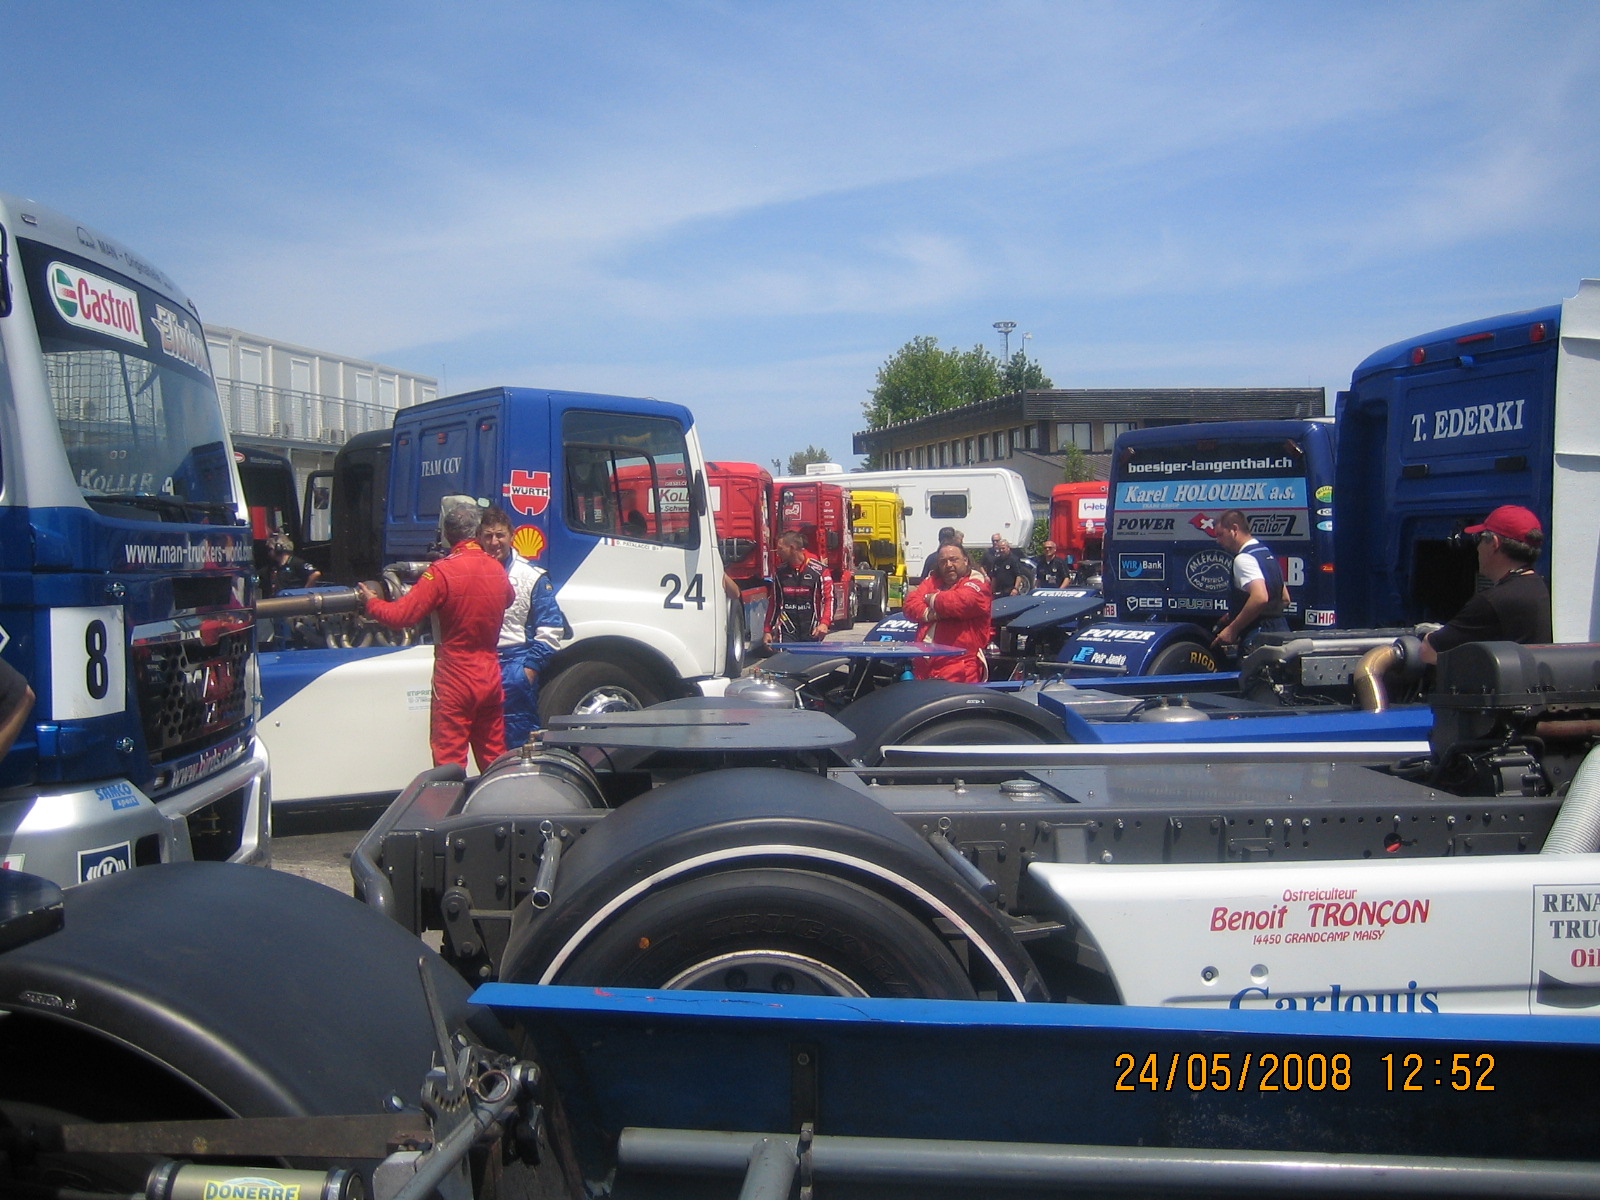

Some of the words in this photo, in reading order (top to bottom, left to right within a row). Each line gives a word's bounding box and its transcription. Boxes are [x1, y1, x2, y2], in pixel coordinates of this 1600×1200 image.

[77, 277, 139, 336] Castrol
[1412, 413, 1427, 442] T.
[1433, 400, 1525, 440] EDERKI
[421, 459, 441, 477] TEAM
[443, 457, 462, 474] CCV
[1128, 457, 1293, 475] boesiger-langenthal.ch
[660, 489, 690, 502] KOL
[1124, 485, 1169, 504] Karel
[1174, 483, 1268, 503] HOLOUBEK
[1117, 518, 1176, 531] POWER
[1121, 560, 1139, 570] WIR
[1142, 560, 1163, 570] Bank
[659, 573, 706, 611] 24
[1138, 597, 1163, 609] ECS
[880, 619, 919, 629] POW
[1079, 628, 1156, 640] POWER
[85, 619, 109, 700] 8
[95, 783, 132, 801] SAMCO
[1282, 887, 1358, 902] Ostreiculteur
[1542, 893, 1600, 913] RENA
[1210, 904, 1288, 932] Benoit
[1307, 899, 1430, 928] TRONÇON
[1252, 934, 1282, 945] 14450
[1284, 931, 1350, 944] GRANDCAMP
[1352, 929, 1385, 941] MAISY
[1549, 919, 1600, 939] TRU
